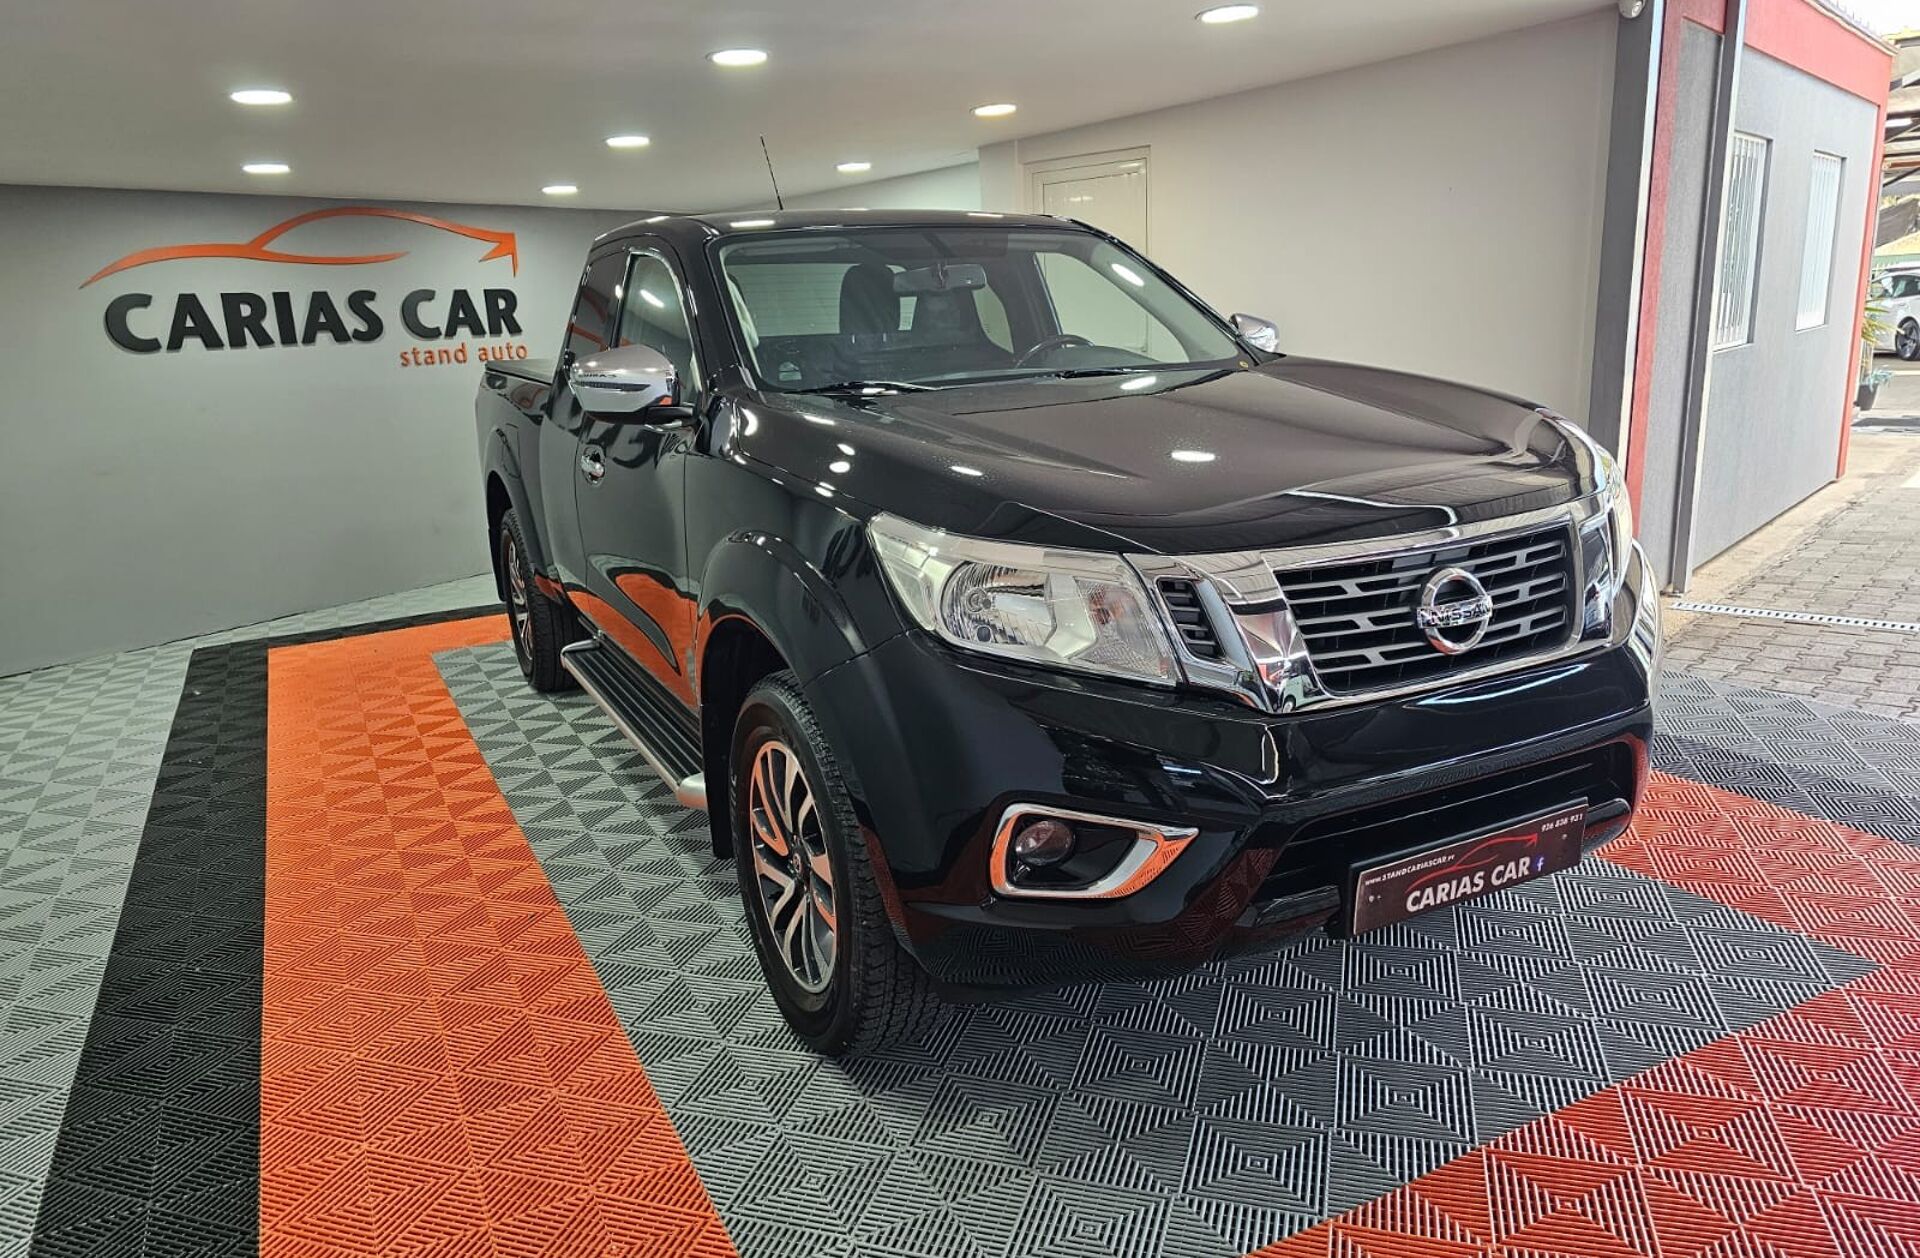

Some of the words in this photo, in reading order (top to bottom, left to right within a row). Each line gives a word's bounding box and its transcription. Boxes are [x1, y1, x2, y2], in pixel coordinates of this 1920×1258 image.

[104, 289, 385, 354] CARIAS
[401, 288, 523, 339] CAR
[400, 343, 468, 367] stand
[479, 343, 529, 362] auto
[1420, 601, 1491, 627] NISSAN
[1405, 870, 1484, 913] CARIAS
[1491, 855, 1530, 886] CAR
